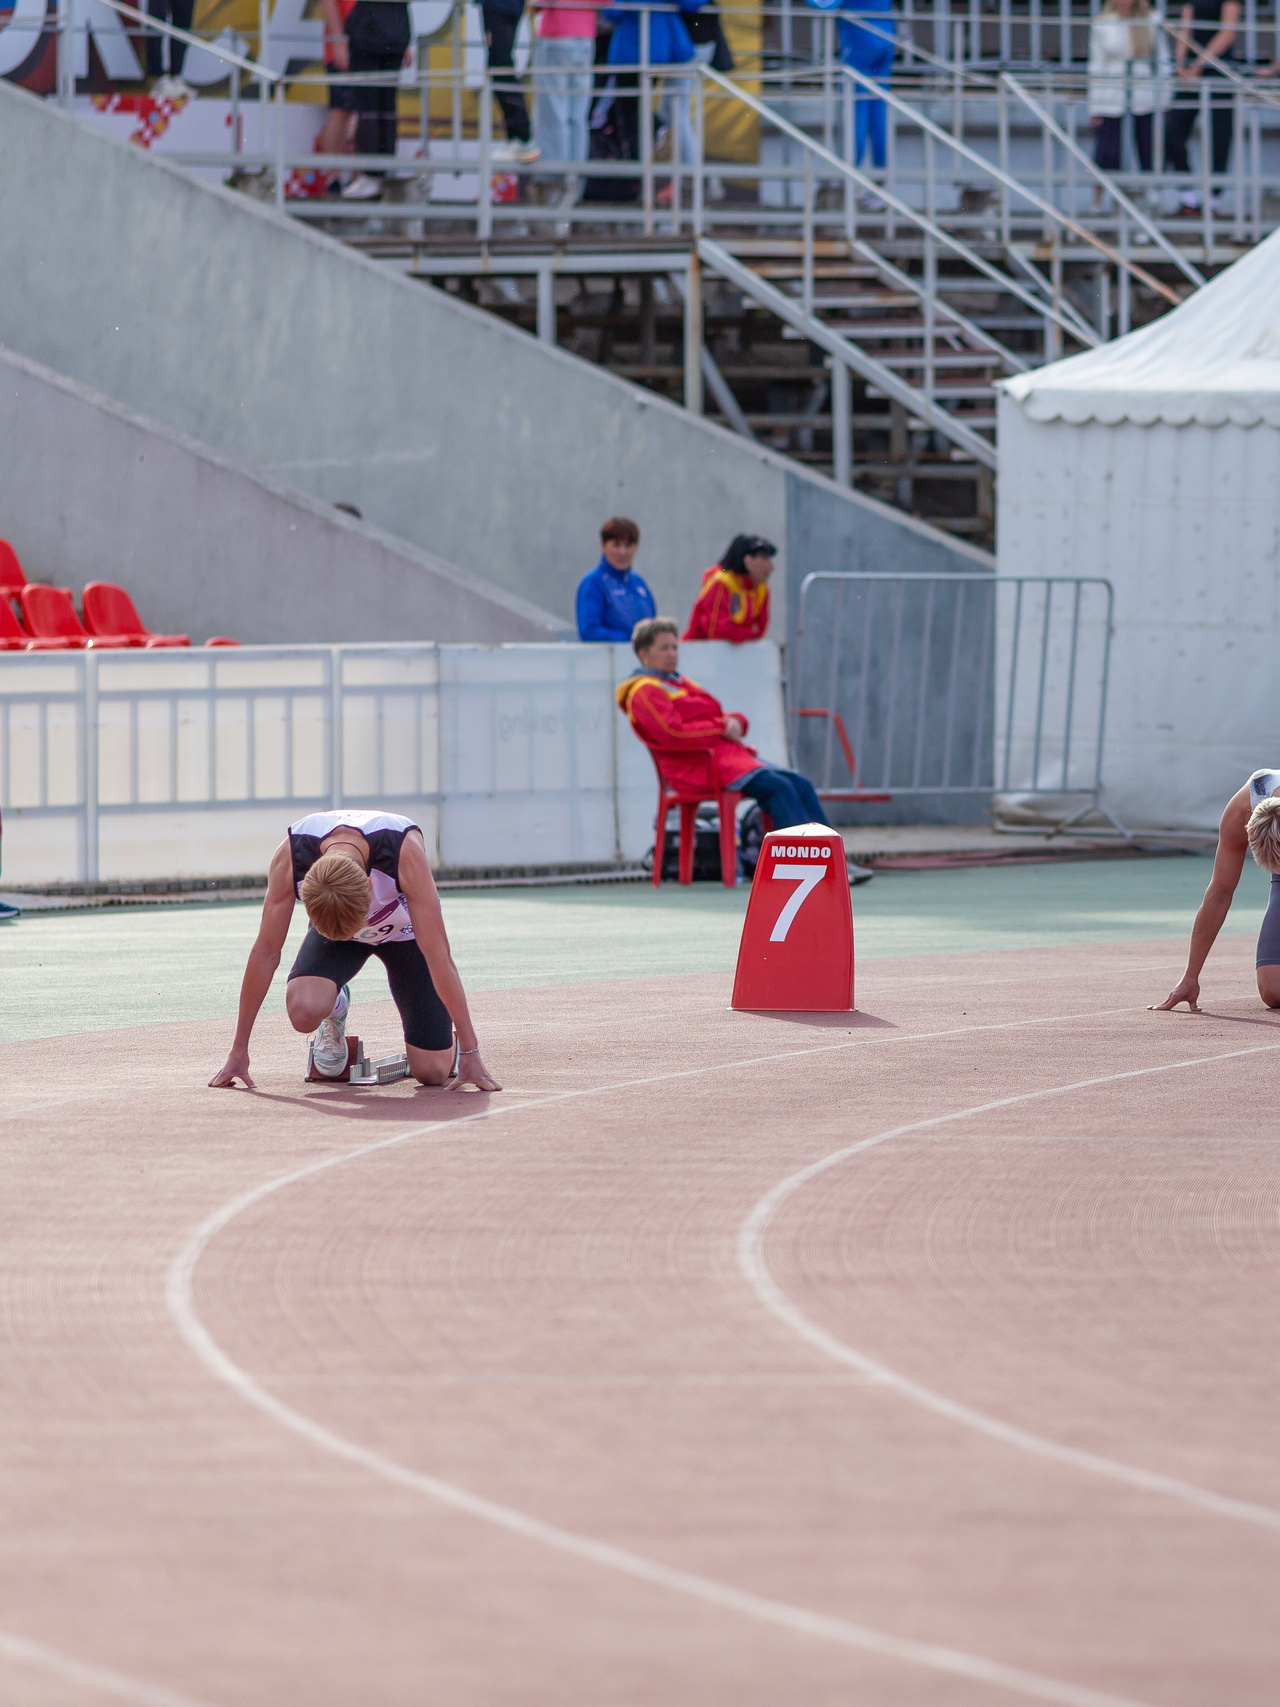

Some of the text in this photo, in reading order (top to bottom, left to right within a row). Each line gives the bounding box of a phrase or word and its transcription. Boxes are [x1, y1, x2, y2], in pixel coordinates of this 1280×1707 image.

[771, 846, 831, 858] MONDO
[769, 864, 828, 942] 7
[352, 925, 395, 939] 69
